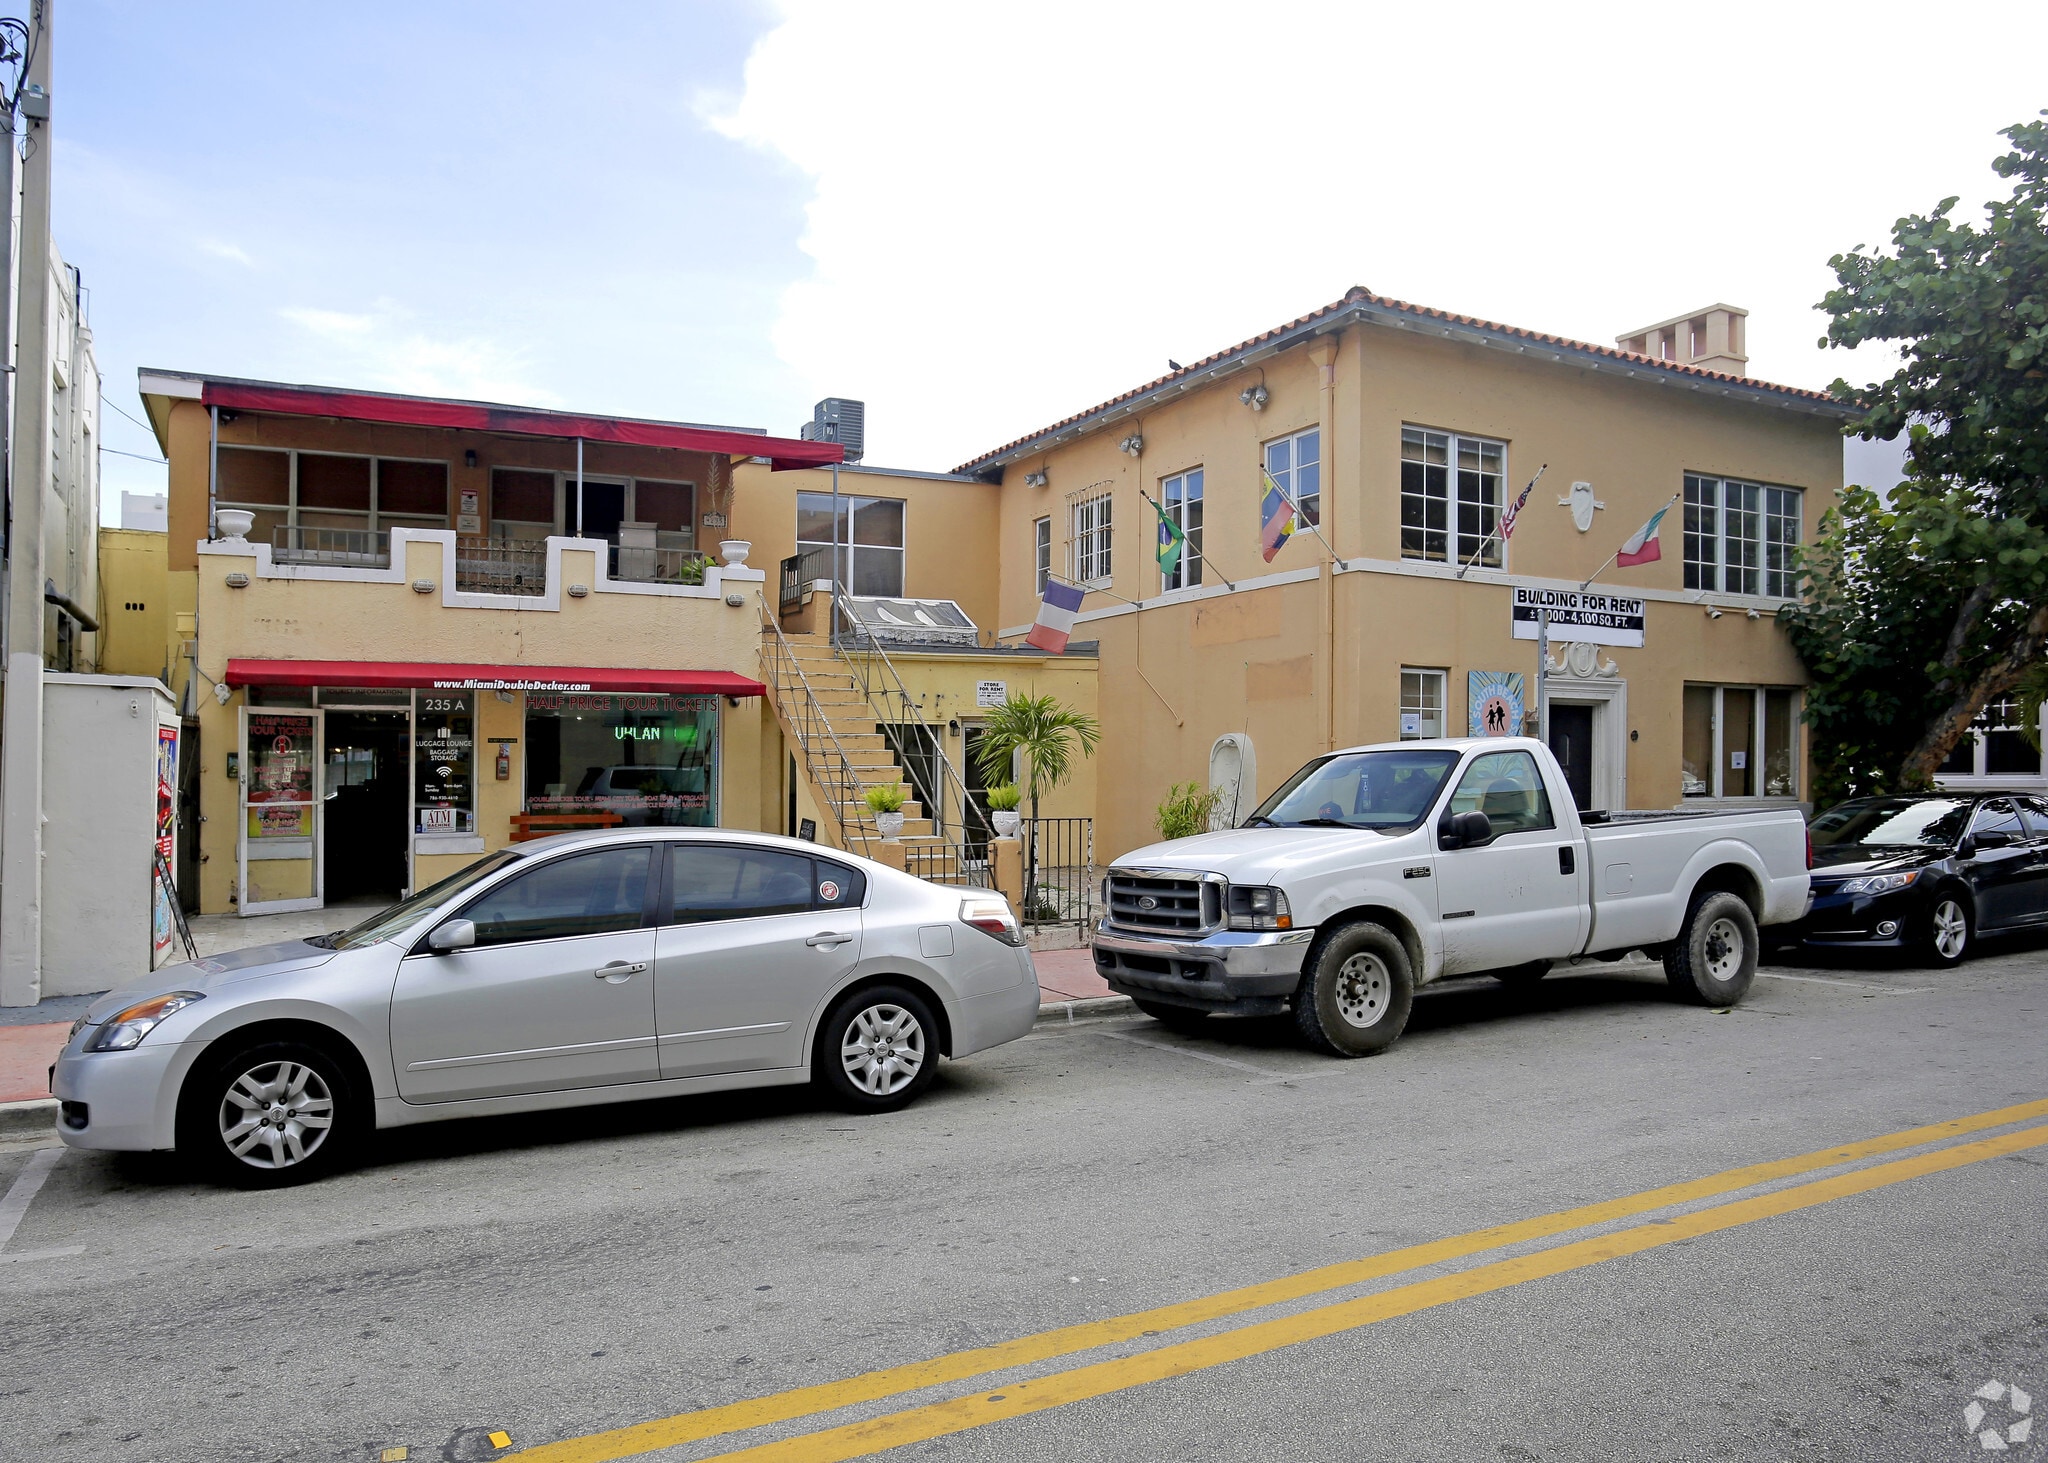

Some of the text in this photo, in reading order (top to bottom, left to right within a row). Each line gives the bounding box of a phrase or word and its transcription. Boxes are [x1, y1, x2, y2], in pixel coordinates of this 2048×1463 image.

[1517, 590, 1641, 614] BUILDING FOR RENT
[1571, 612, 1598, 624] 4,100
[1600, 614, 1614, 626] SQ.
[1615, 616, 1628, 627] FT.
[433, 679, 591, 691] www.MiamiDoubleDecker.com
[425, 699, 465, 711] 235 A
[524, 695, 718, 712] HALF PRICE TOUR TICKETS
[1473, 684, 1520, 719] SOUTH BEACH
[282, 717, 309, 727] PRICE
[249, 726, 314, 737] TOUR TICKETS
[427, 810, 451, 824] ATM
